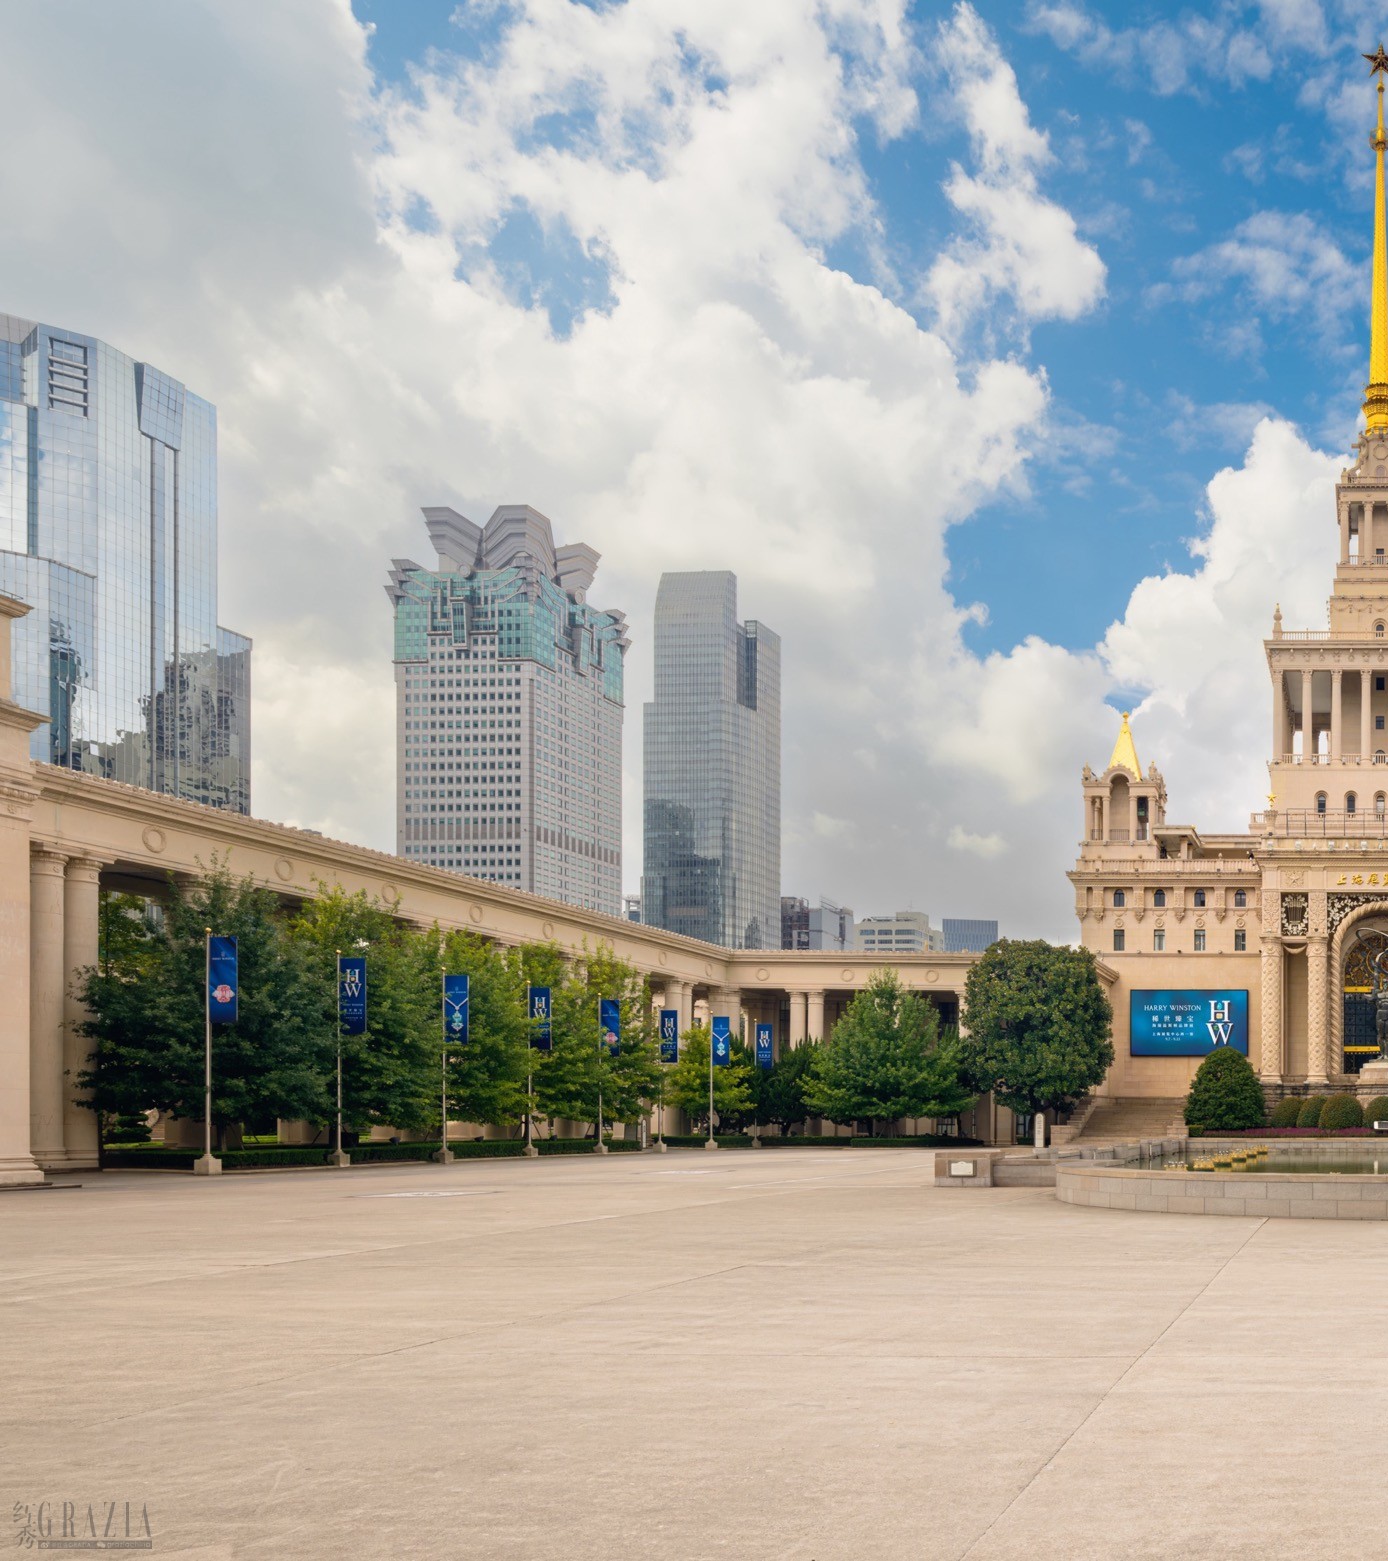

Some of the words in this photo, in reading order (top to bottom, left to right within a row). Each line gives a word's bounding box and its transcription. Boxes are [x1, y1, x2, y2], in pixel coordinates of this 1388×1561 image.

[346, 969, 360, 983] H
[344, 983, 362, 998] W
[1208, 1000, 1231, 1022] H
[1205, 1022, 1234, 1045] W
